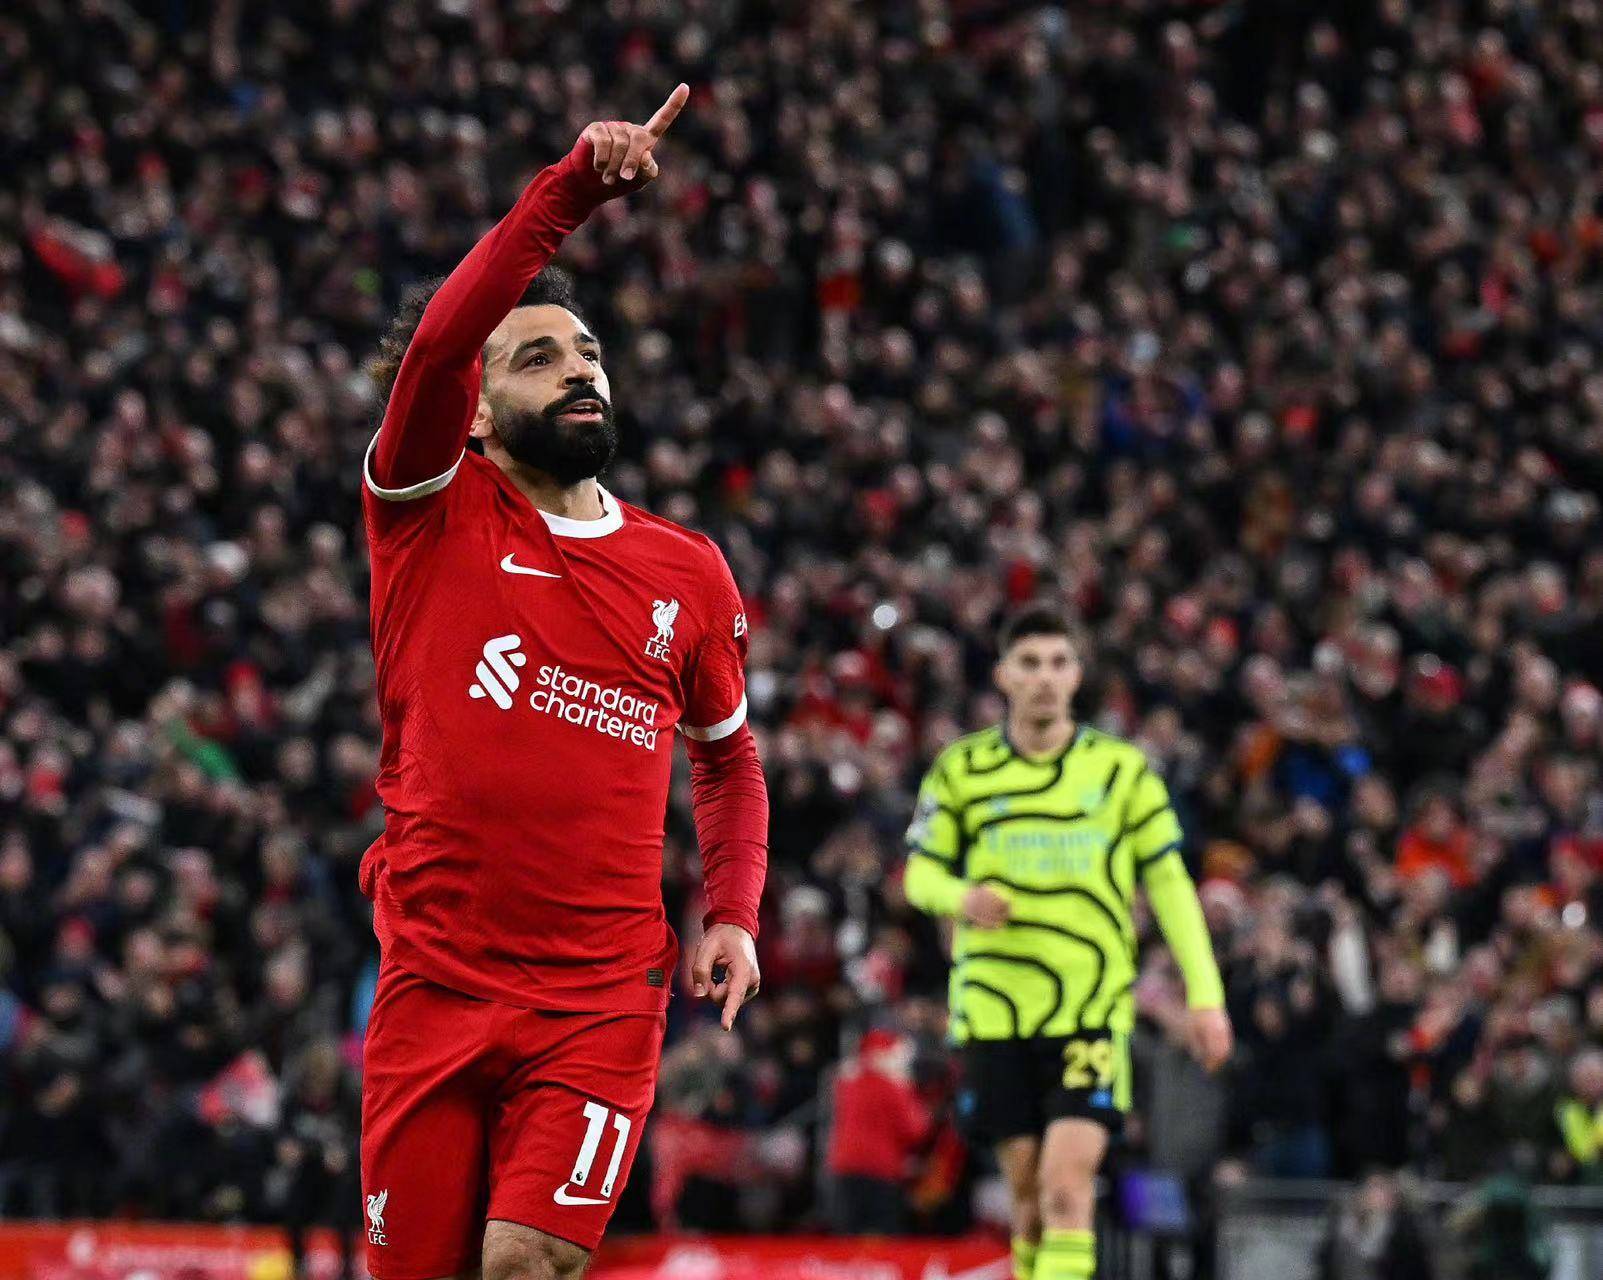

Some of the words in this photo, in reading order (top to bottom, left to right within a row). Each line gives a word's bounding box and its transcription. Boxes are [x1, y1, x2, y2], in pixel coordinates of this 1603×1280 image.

[529, 690, 659, 751] chartered
[536, 665, 659, 727] standard
[1062, 1038, 1112, 1089] 29
[569, 1100, 632, 1198] 11
